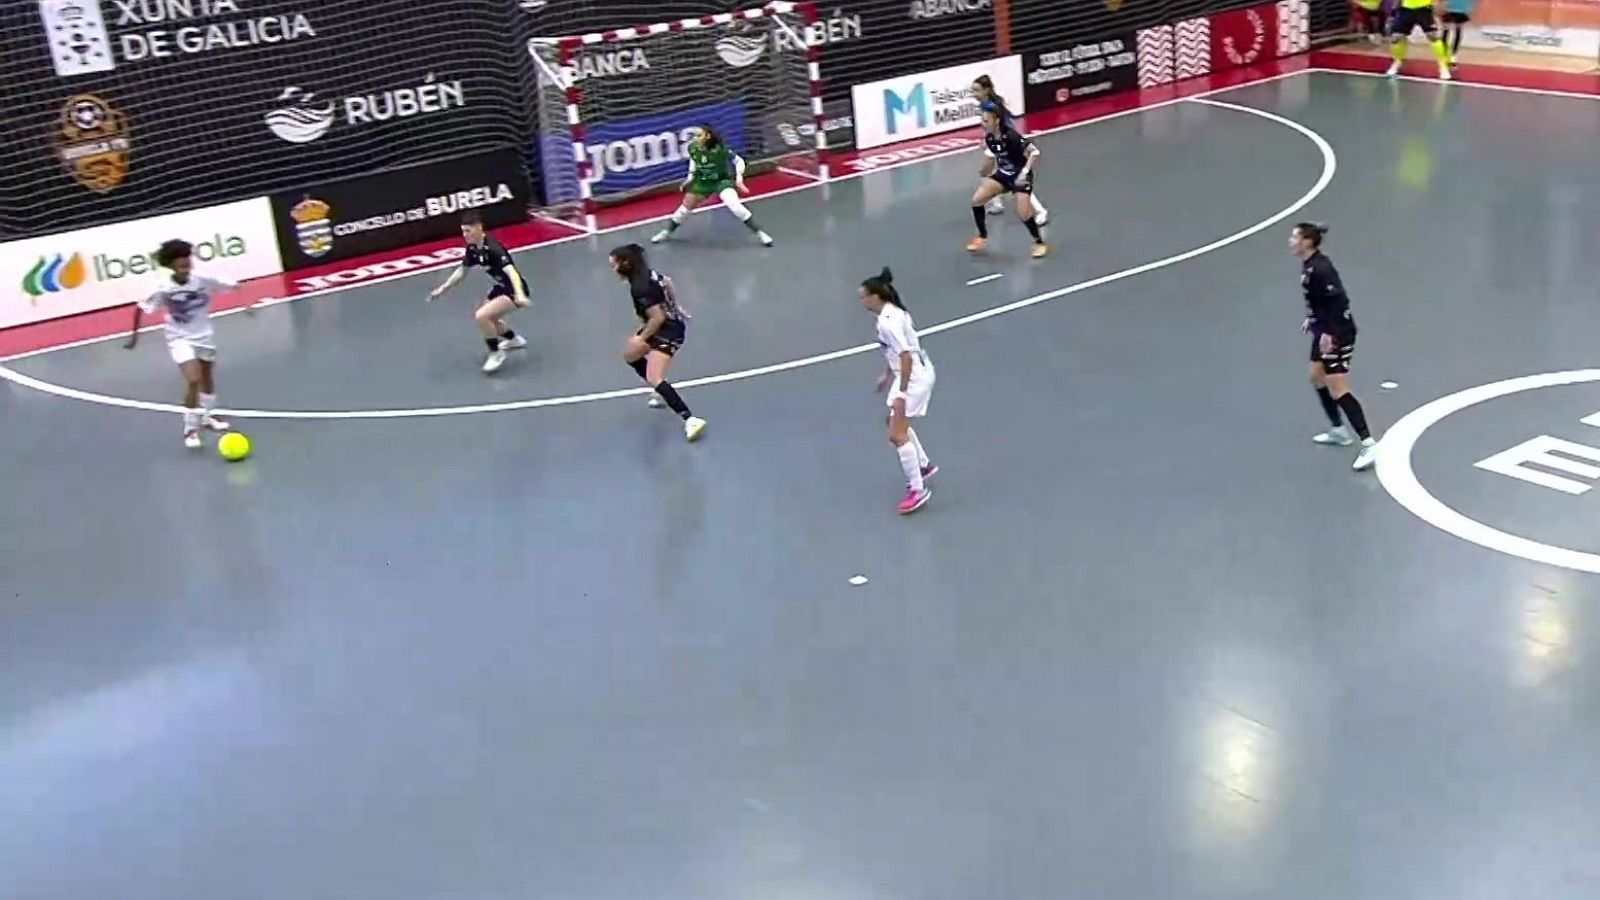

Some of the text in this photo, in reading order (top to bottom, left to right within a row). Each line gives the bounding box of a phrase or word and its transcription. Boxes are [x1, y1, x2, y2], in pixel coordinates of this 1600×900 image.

[120, 14, 317, 60] DE GALICIA
[774, 7, 862, 52] RBÉN
[557, 47, 651, 83] BANCA
[343, 71, 466, 124] RUBÉN
[333, 183, 514, 237] CONCELLO DE BURELA
[93, 232, 246, 282] Iberola
